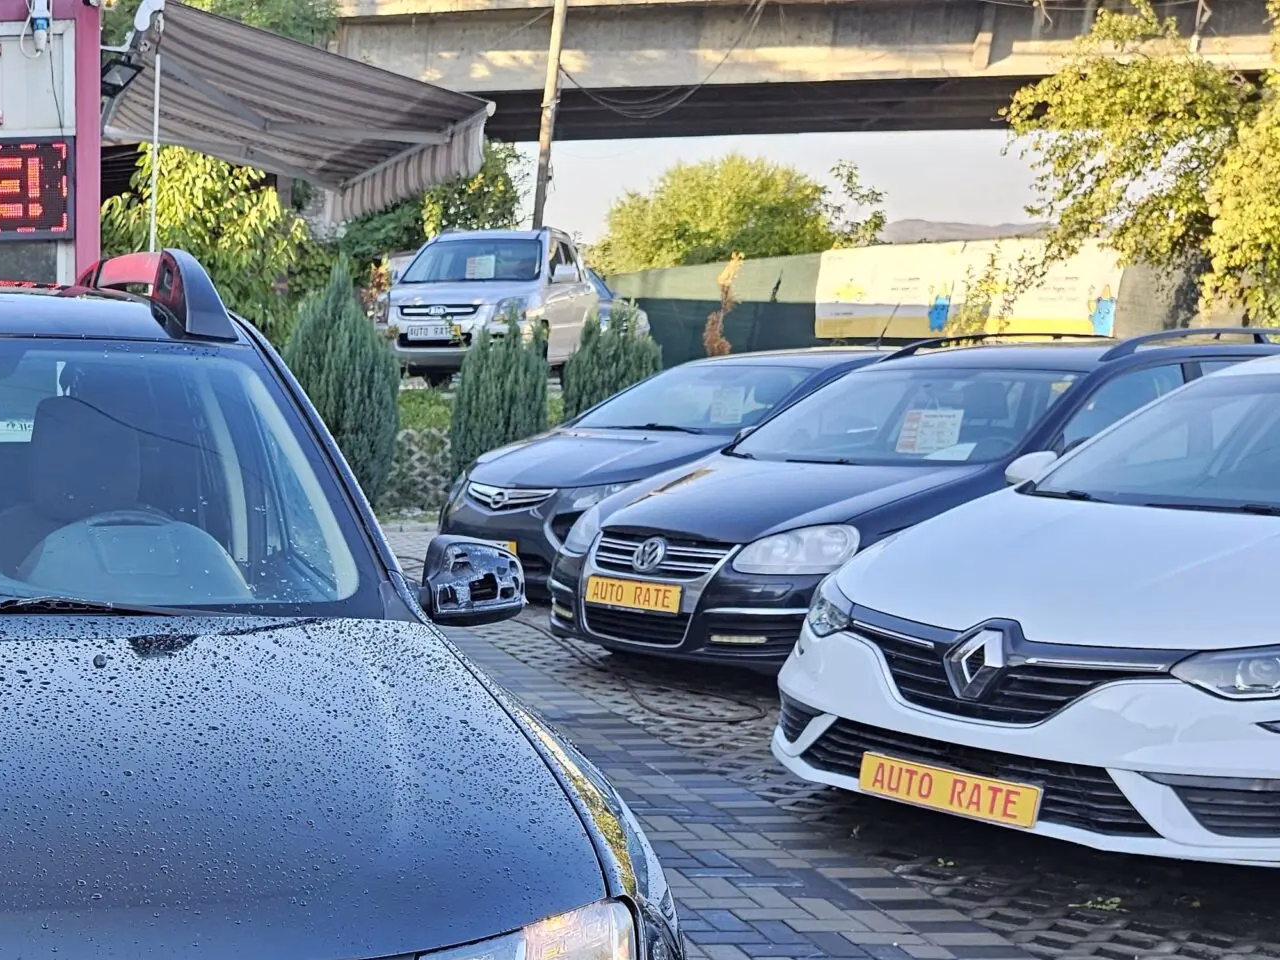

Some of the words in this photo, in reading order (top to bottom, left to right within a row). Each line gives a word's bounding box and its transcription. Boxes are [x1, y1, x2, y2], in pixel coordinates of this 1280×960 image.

[592, 581, 624, 603] AUTO
[633, 585, 672, 609] RATE
[871, 761, 934, 800] AUTO
[948, 777, 1022, 820] RATE
